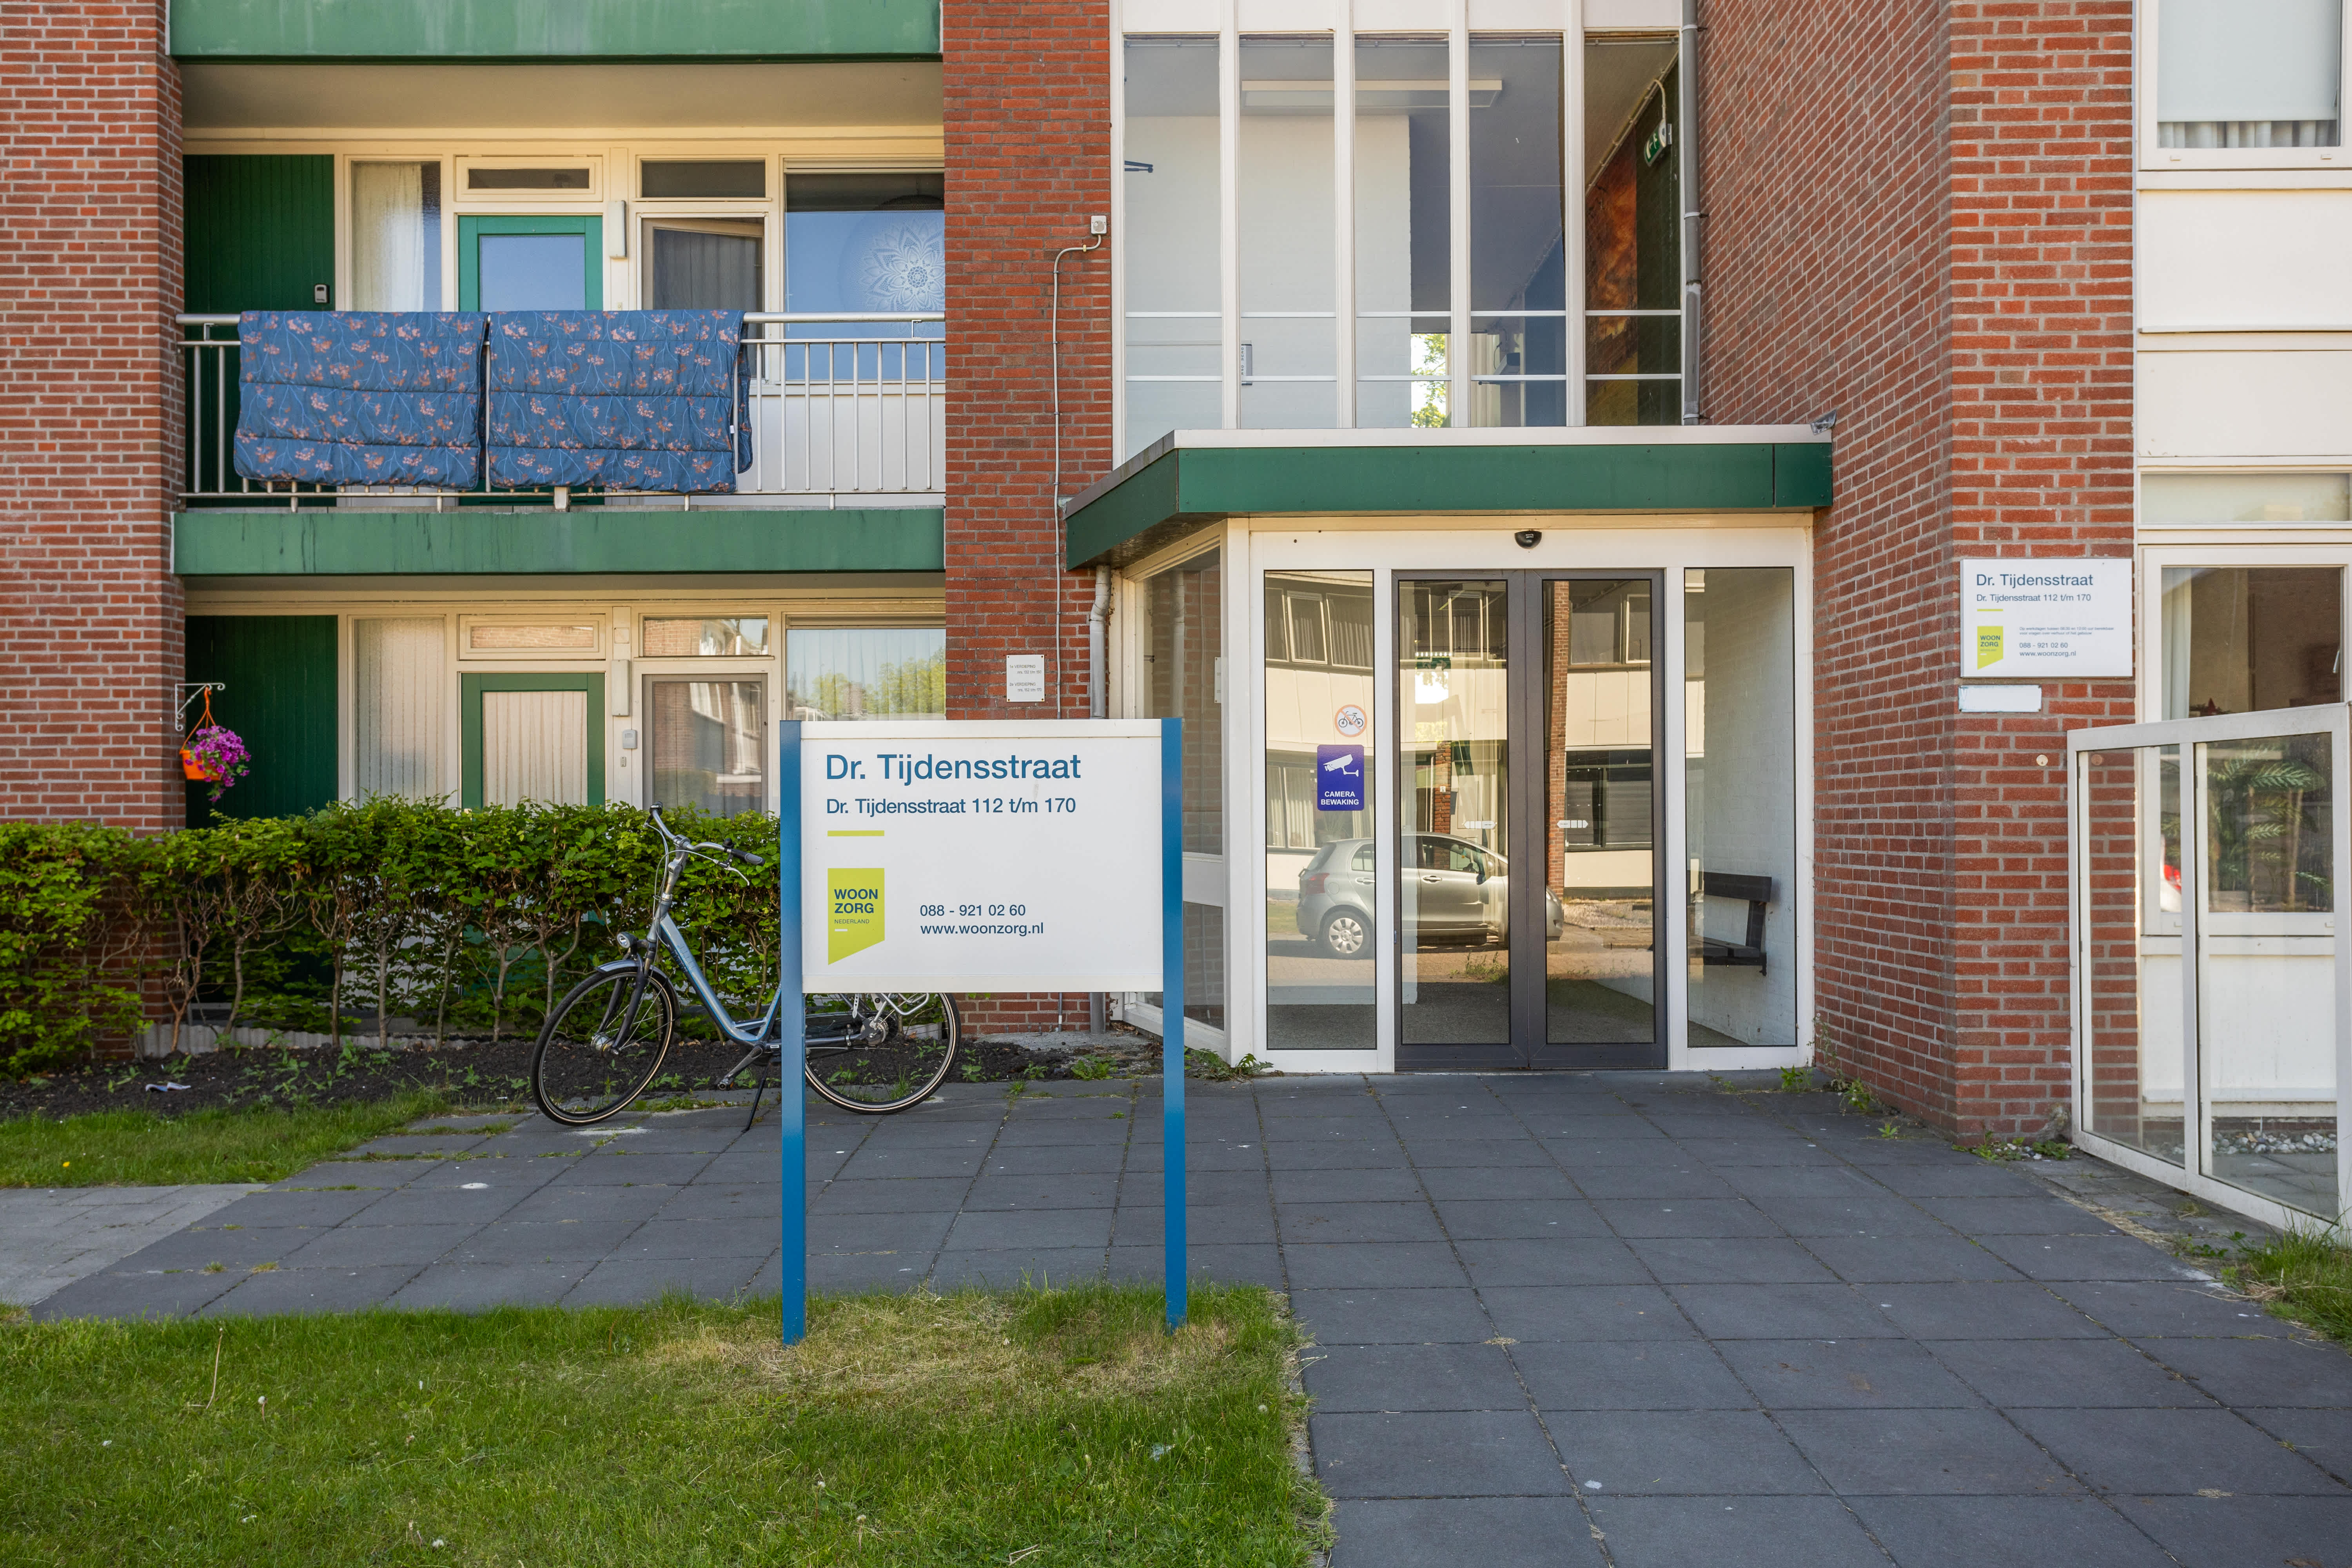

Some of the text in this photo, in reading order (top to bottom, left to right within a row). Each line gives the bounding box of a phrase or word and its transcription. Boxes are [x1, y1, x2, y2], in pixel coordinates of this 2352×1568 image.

[1976, 573, 2094, 589] Dr. Tijdensstraat
[1989, 594, 2041, 603] Tijdensstraat
[826, 753, 1082, 786] Dr. Tijdensstraat
[827, 797, 1076, 818] Dr. Tijdensstraat 112 t/m 170
[834, 888, 878, 900] WOON
[834, 902, 875, 914] ZORG
[920, 904, 945, 916] 088
[959, 904, 982, 916] 921
[988, 904, 1005, 916] 02
[1009, 904, 1026, 916] 60
[920, 922, 1044, 937] www.woonzorg.nl
